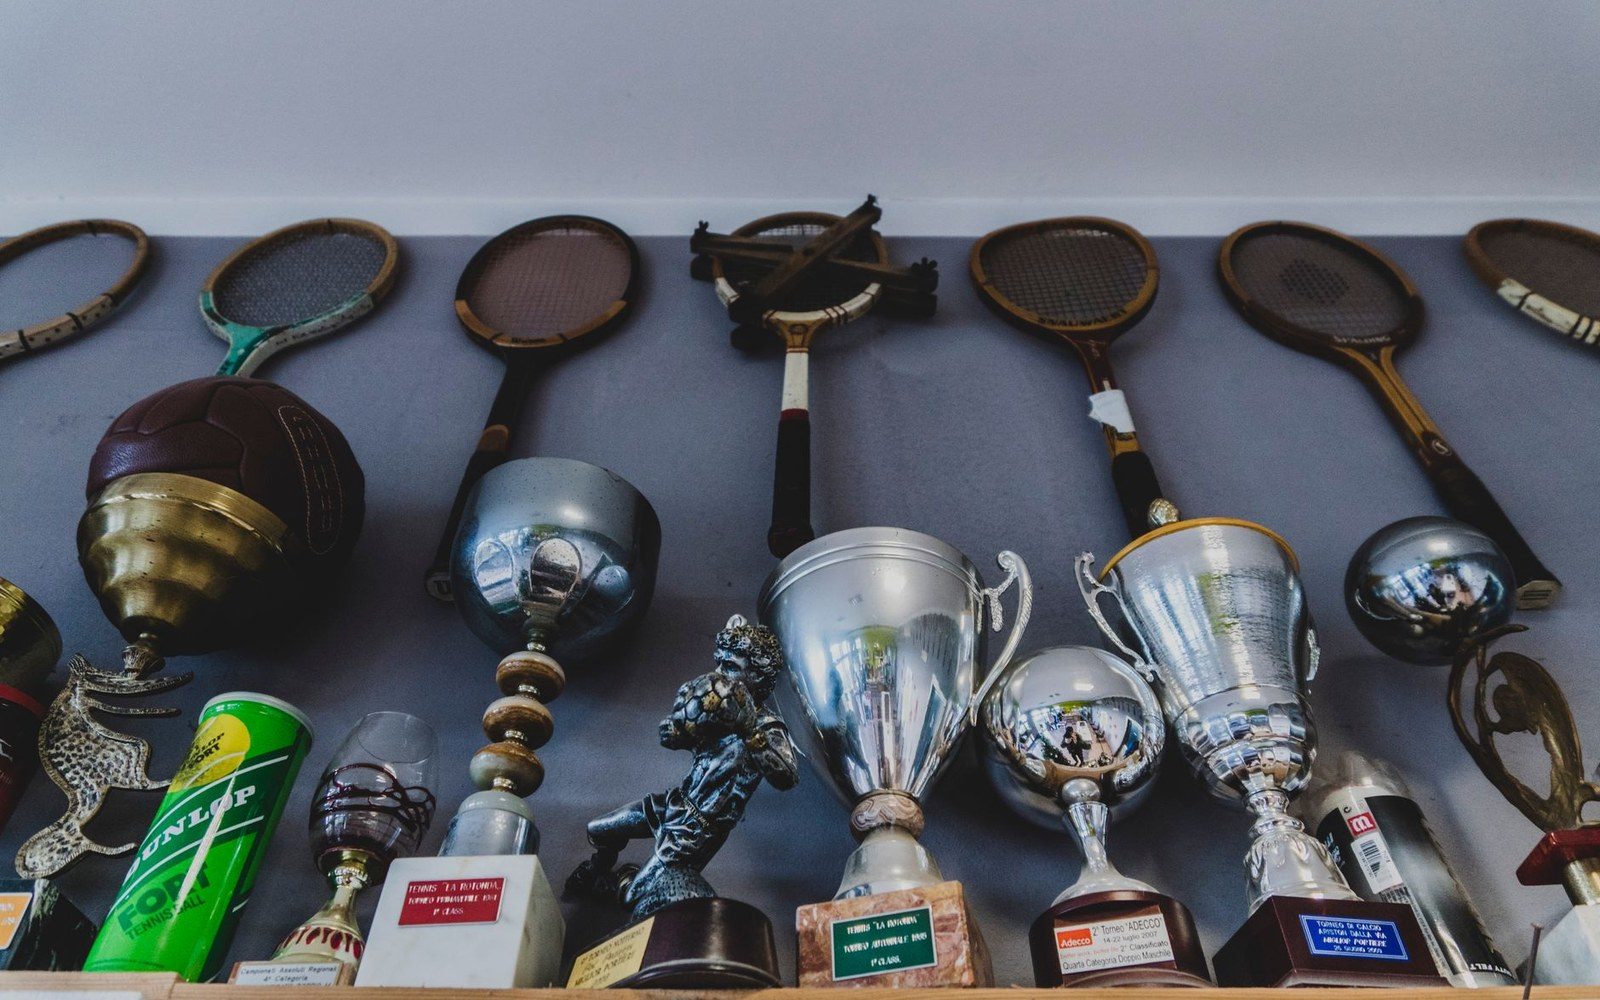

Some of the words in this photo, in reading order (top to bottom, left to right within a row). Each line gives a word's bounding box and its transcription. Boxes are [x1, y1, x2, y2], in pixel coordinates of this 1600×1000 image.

[121, 784, 257, 887] DUNLOP
[409, 884, 437, 894] TENNIS
[117, 861, 211, 931] FORT
[408, 896, 435, 905] TORNEO
[125, 908, 174, 940] TENNIS
[847, 923, 871, 935] TENNIS
[1101, 924, 1125, 935] Torneo
[1316, 920, 1344, 929] TORNEO
[1356, 923, 1382, 931] CALCIO
[1122, 933, 1140, 943] luglio
[1141, 930, 1158, 939] 2007
[1318, 928, 1348, 936] ARISTON
[1350, 930, 1372, 938] DALLA
[1374, 931, 1387, 939] VIA
[843, 941, 870, 953] TORNEO
[1060, 938, 1091, 948] Adecco
[1129, 940, 1169, 951] Classificato
[1323, 937, 1351, 945] MIGLIOR
[1354, 938, 1387, 947] PORTIERE
[1062, 959, 1085, 970] Quarta
[1087, 957, 1117, 969] Categoria
[1118, 953, 1141, 965] Doppio
[1142, 949, 1171, 960] Maschile
[275, 975, 308, 983] Categoria
